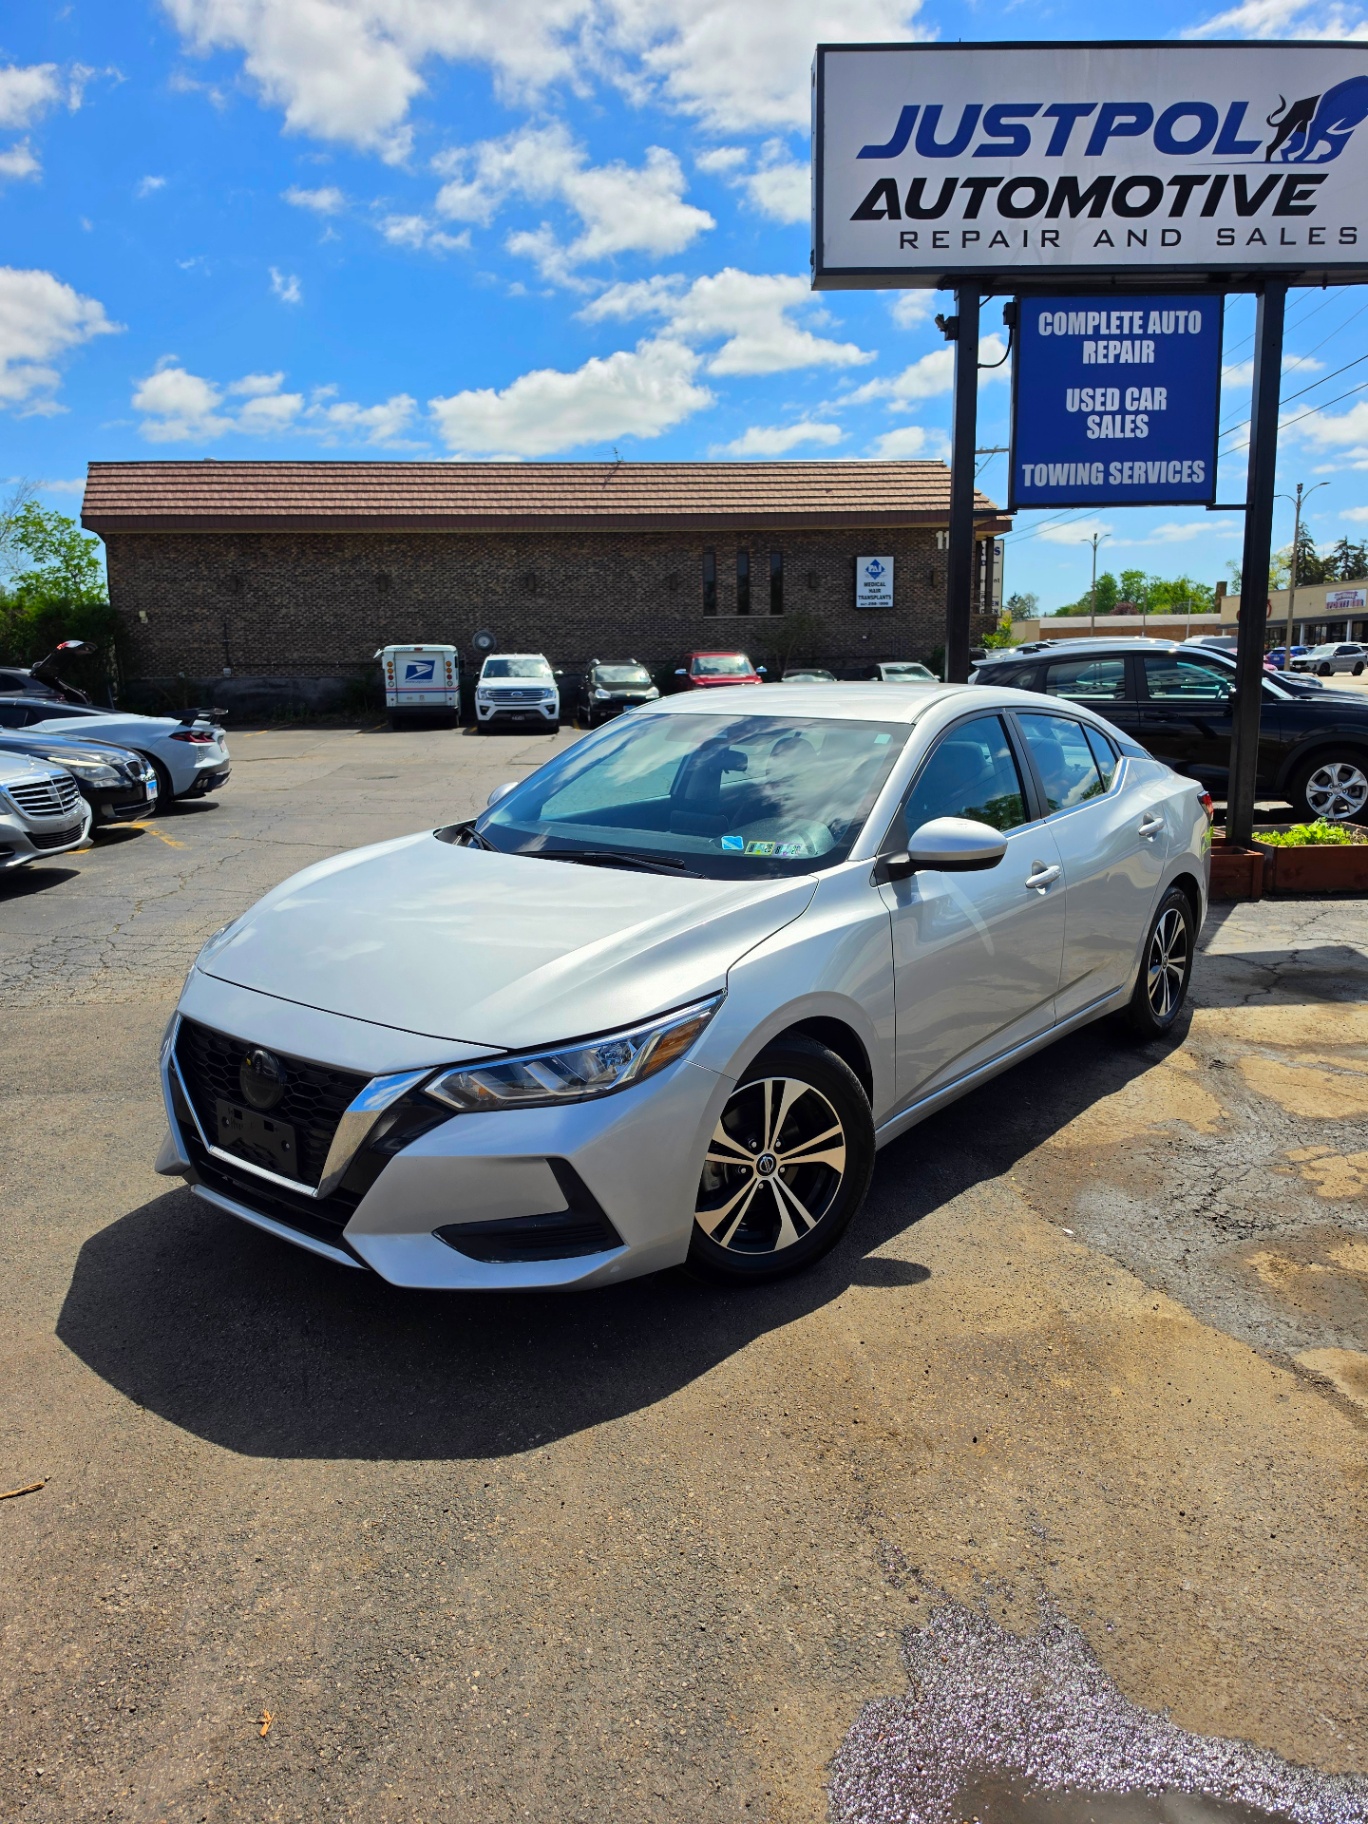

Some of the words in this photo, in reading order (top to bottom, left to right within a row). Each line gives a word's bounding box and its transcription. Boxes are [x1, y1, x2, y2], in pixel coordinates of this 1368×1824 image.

[856, 101, 1262, 159] JUSTPOL
[849, 172, 1330, 220] AUTOMOTIVE
[899, 228, 1061, 249] REPAIR
[1094, 228, 1182, 248] AND
[1216, 226, 1358, 246] SALES
[1038, 311, 1144, 336] COMPLETE
[1147, 310, 1202, 335] AUTO
[1082, 340, 1155, 364] REPAIR
[1066, 387, 1120, 412] USED
[1125, 387, 1167, 411] CAR
[1086, 414, 1149, 439] SALES
[1022, 462, 1104, 487] TOWING
[1108, 460, 1205, 485] SERVICES
